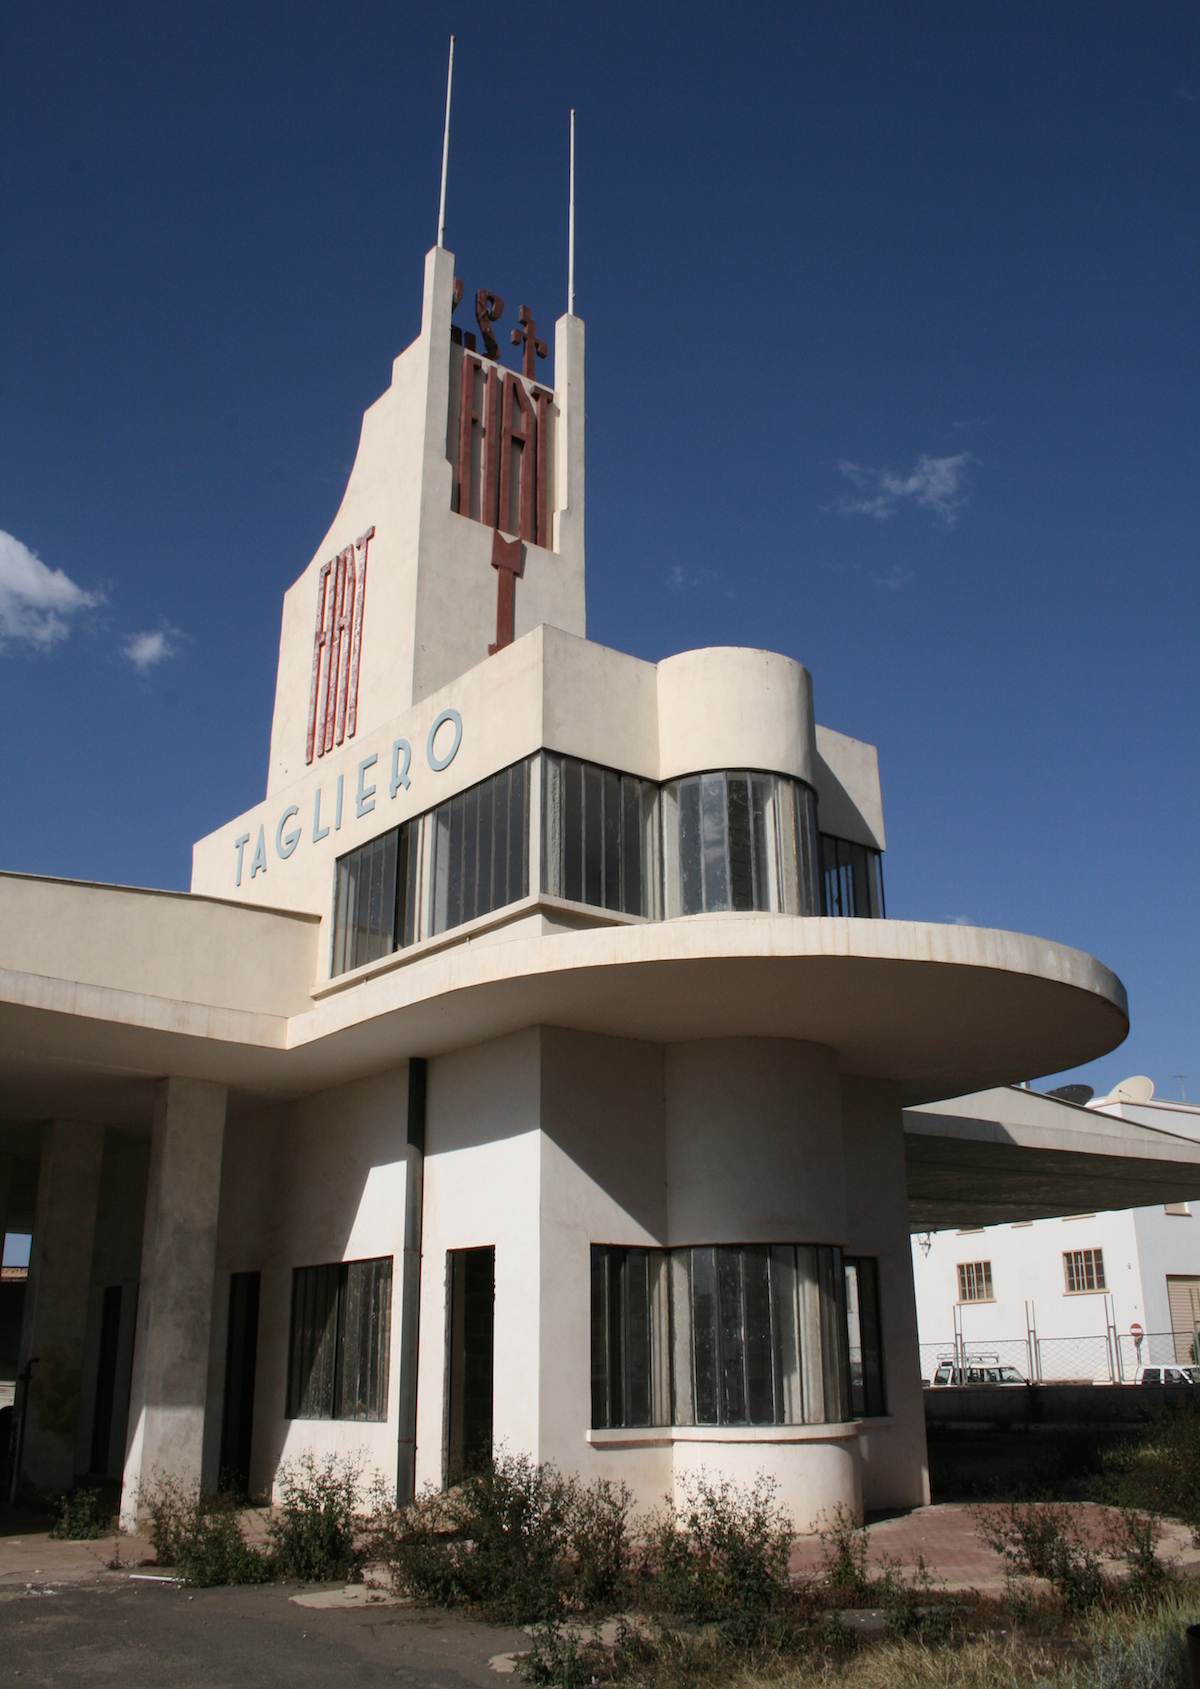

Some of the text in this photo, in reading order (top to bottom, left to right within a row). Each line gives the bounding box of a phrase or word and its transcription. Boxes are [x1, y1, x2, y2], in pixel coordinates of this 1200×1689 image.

[458, 353, 554, 549] FIAT
[305, 525, 375, 765] FIAT
[235, 709, 463, 887] TAGLIERO
